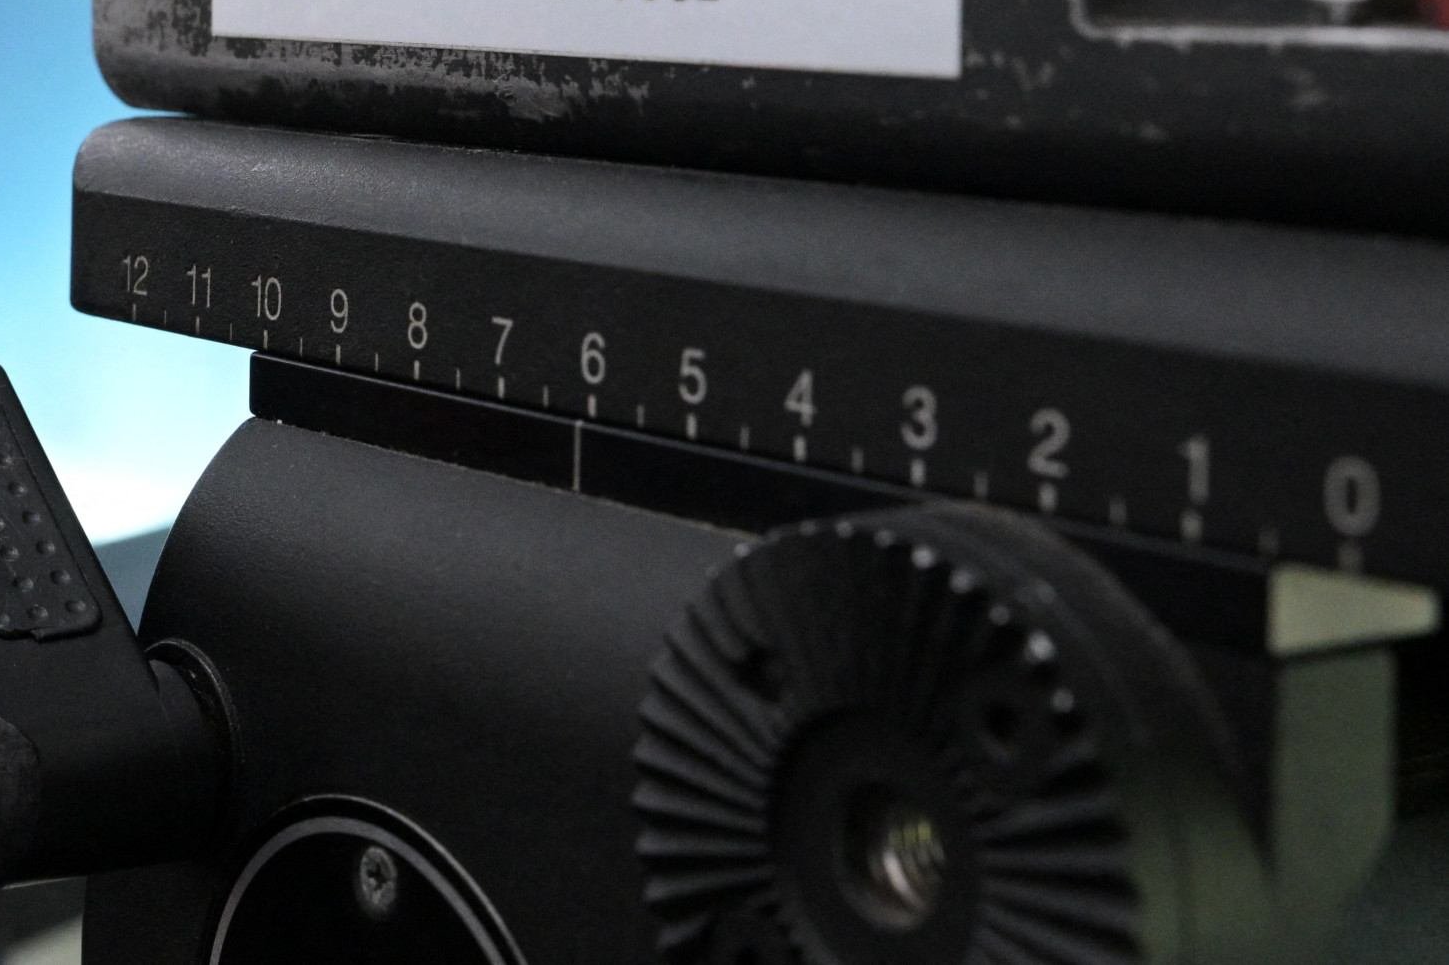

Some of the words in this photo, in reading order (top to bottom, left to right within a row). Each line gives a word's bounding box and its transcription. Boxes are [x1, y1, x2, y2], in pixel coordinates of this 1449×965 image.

[122, 254, 149, 296] 12
[186, 264, 213, 308] 11
[251, 274, 282, 321] 10
[329, 288, 349, 333] 9
[407, 301, 428, 350] 8
[491, 316, 514, 366] 7
[580, 332, 606, 385] 6
[678, 347, 707, 406] 5
[784, 369, 817, 427] 4
[901, 385, 938, 450] 3
[1027, 407, 1071, 478] 2
[1180, 436, 1211, 504] 1
[1323, 455, 1382, 536] 0
